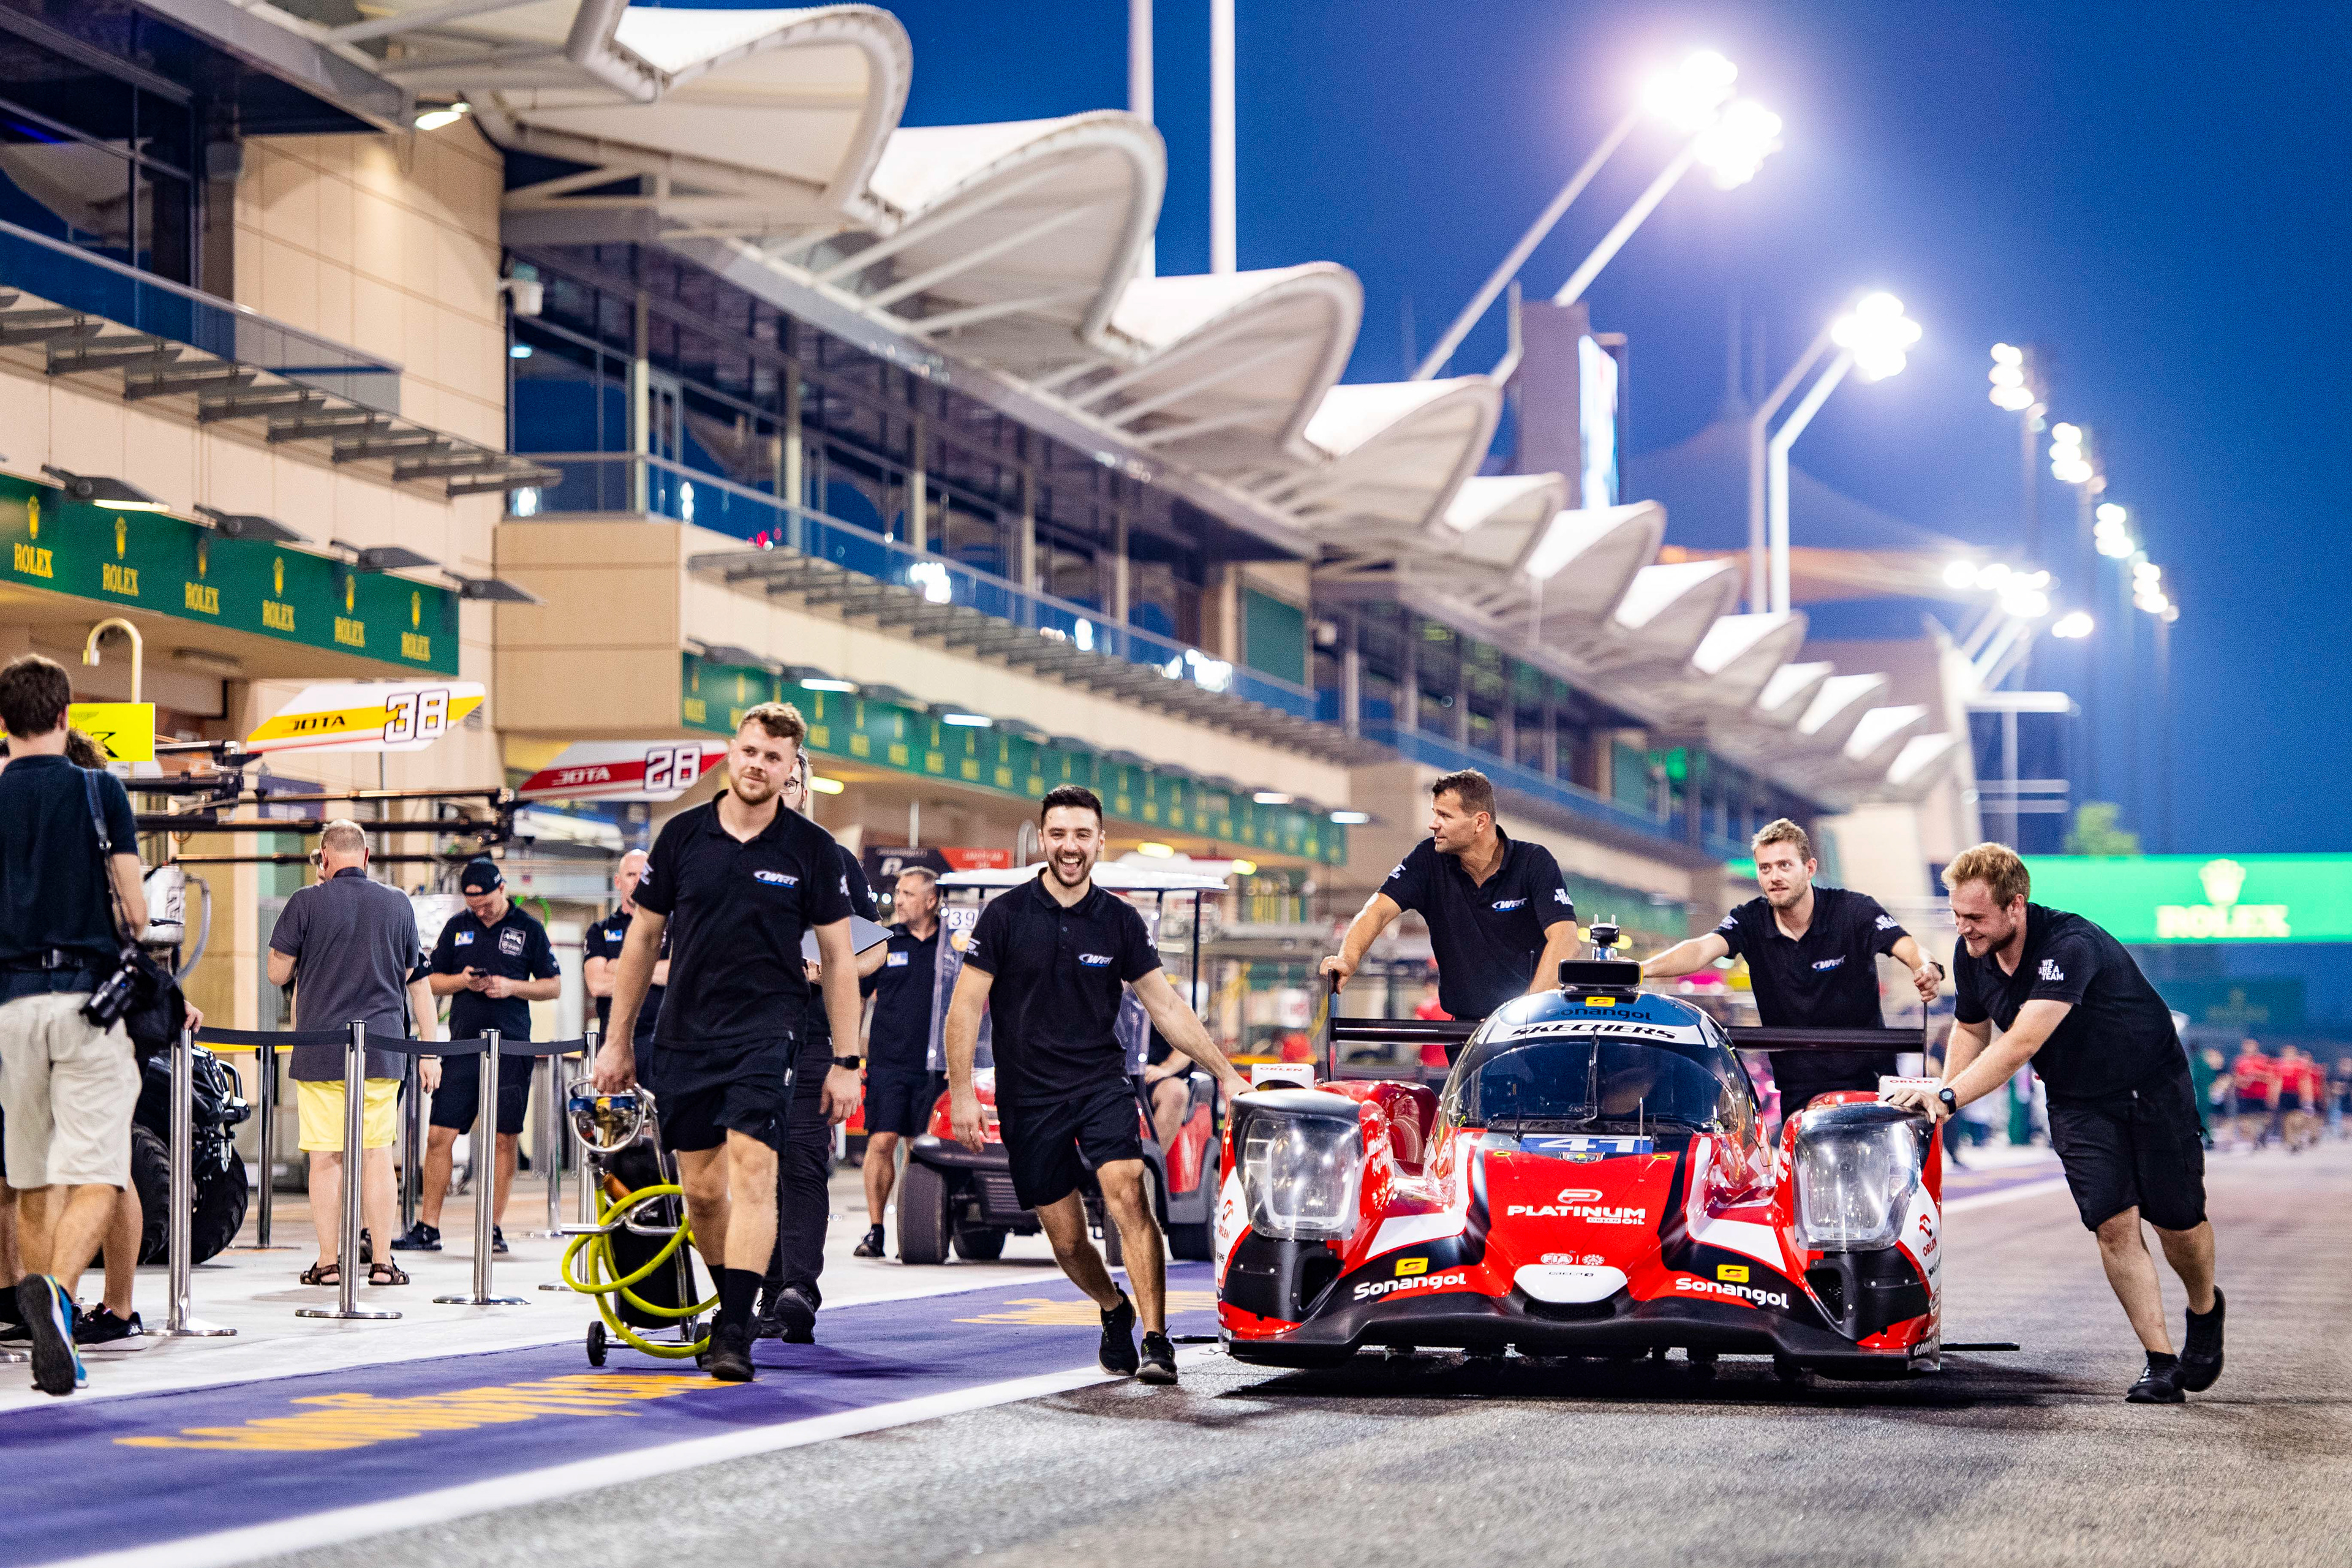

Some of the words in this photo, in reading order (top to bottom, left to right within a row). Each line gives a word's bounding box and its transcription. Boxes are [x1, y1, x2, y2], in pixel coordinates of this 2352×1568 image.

[14, 542, 54, 579] ROLEX
[102, 562, 139, 597] ROLEX
[184, 581, 220, 616] ROLEX
[284, 714, 346, 733] JOTA
[383, 689, 450, 744] 38
[552, 766, 611, 787] JOTA
[644, 743, 702, 793] 28
[951, 911, 976, 927] 39
[2157, 904, 2291, 938] ROLEX
[2041, 972, 2064, 981] TEAM
[1546, 1007, 1653, 1021] Sonangol
[1507, 1023, 1677, 1040] SKECHERS
[1539, 1138, 1635, 1153] 41
[1507, 1205, 1646, 1219] PLATINUM
[1923, 1236, 1937, 1257] ORLEN
[1543, 1254, 1570, 1263] FIA
[1354, 1273, 1467, 1301] Sonangol
[1675, 1278, 1790, 1310] Sonangol
